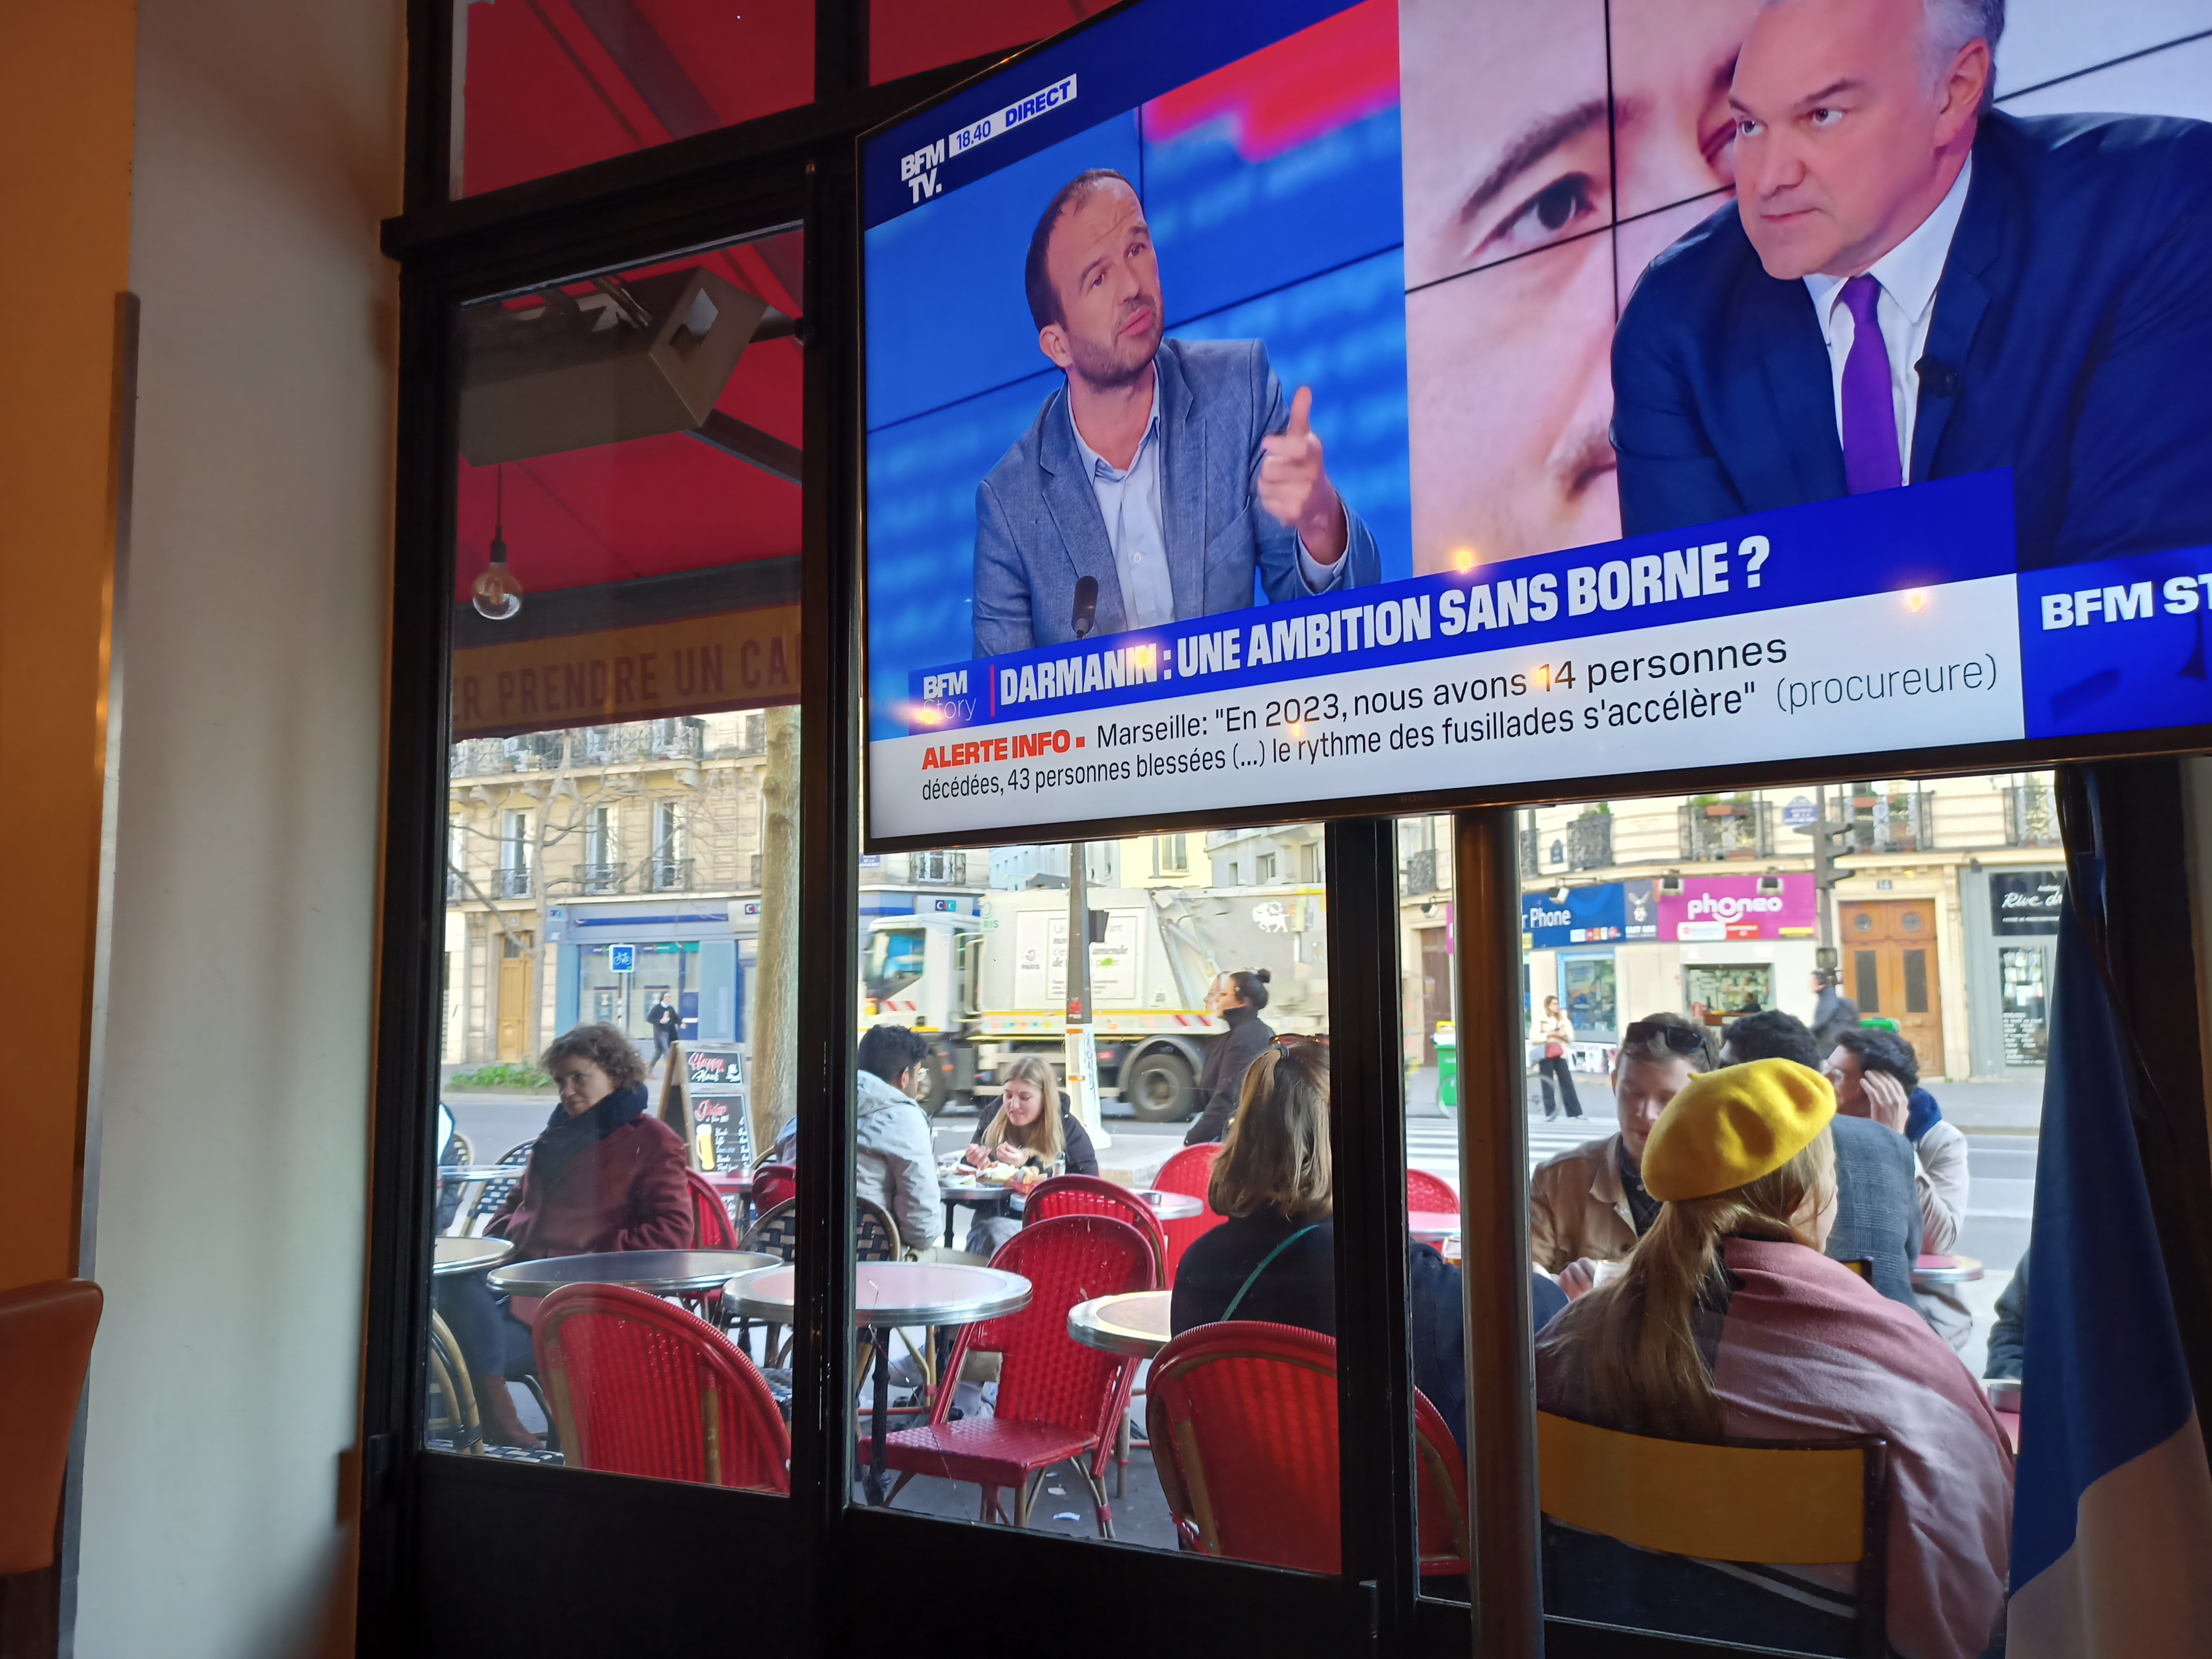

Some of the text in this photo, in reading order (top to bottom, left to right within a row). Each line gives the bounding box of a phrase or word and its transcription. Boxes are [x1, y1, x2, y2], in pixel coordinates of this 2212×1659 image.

[956, 80, 1071, 150] 18.40 DIRECT
[901, 138, 945, 181] BFM
[1000, 643, 1158, 706] DARMANIN
[1178, 628, 1240, 678] UNE
[1247, 594, 1431, 668] AMBITION
[1440, 572, 1558, 636] SANS
[1568, 541, 1729, 617] BORNE
[2041, 581, 2153, 631] BFM
[496, 653, 658, 716] PRENDRE
[673, 645, 723, 695] UN
[922, 739, 1008, 770] ALERTE
[1097, 716, 1207, 749] Marseille:
[1215, 707, 1257, 733] "En
[1265, 693, 1347, 728] 2023,
[1354, 685, 1423, 717] nous
[1433, 673, 1527, 706] avons
[1538, 661, 1576, 693] 14
[1587, 637, 1787, 693] personnes
[924, 670, 967, 700] BFM
[922, 773, 1005, 801] décédées,
[1007, 768, 1030, 792] 43
[1035, 758, 1130, 794] personnes
[1136, 746, 1226, 779] blessées
[1273, 737, 1291, 763] le
[1298, 729, 1381, 765] rythme
[1389, 715, 1434, 750] des
[1442, 706, 1574, 745] fusillades
[1583, 680, 1756, 732] s'accélère"
[1777, 653, 1997, 714] (procureure)
[1530, 908, 1571, 928] Phone
[1688, 892, 1783, 921] phoneo
